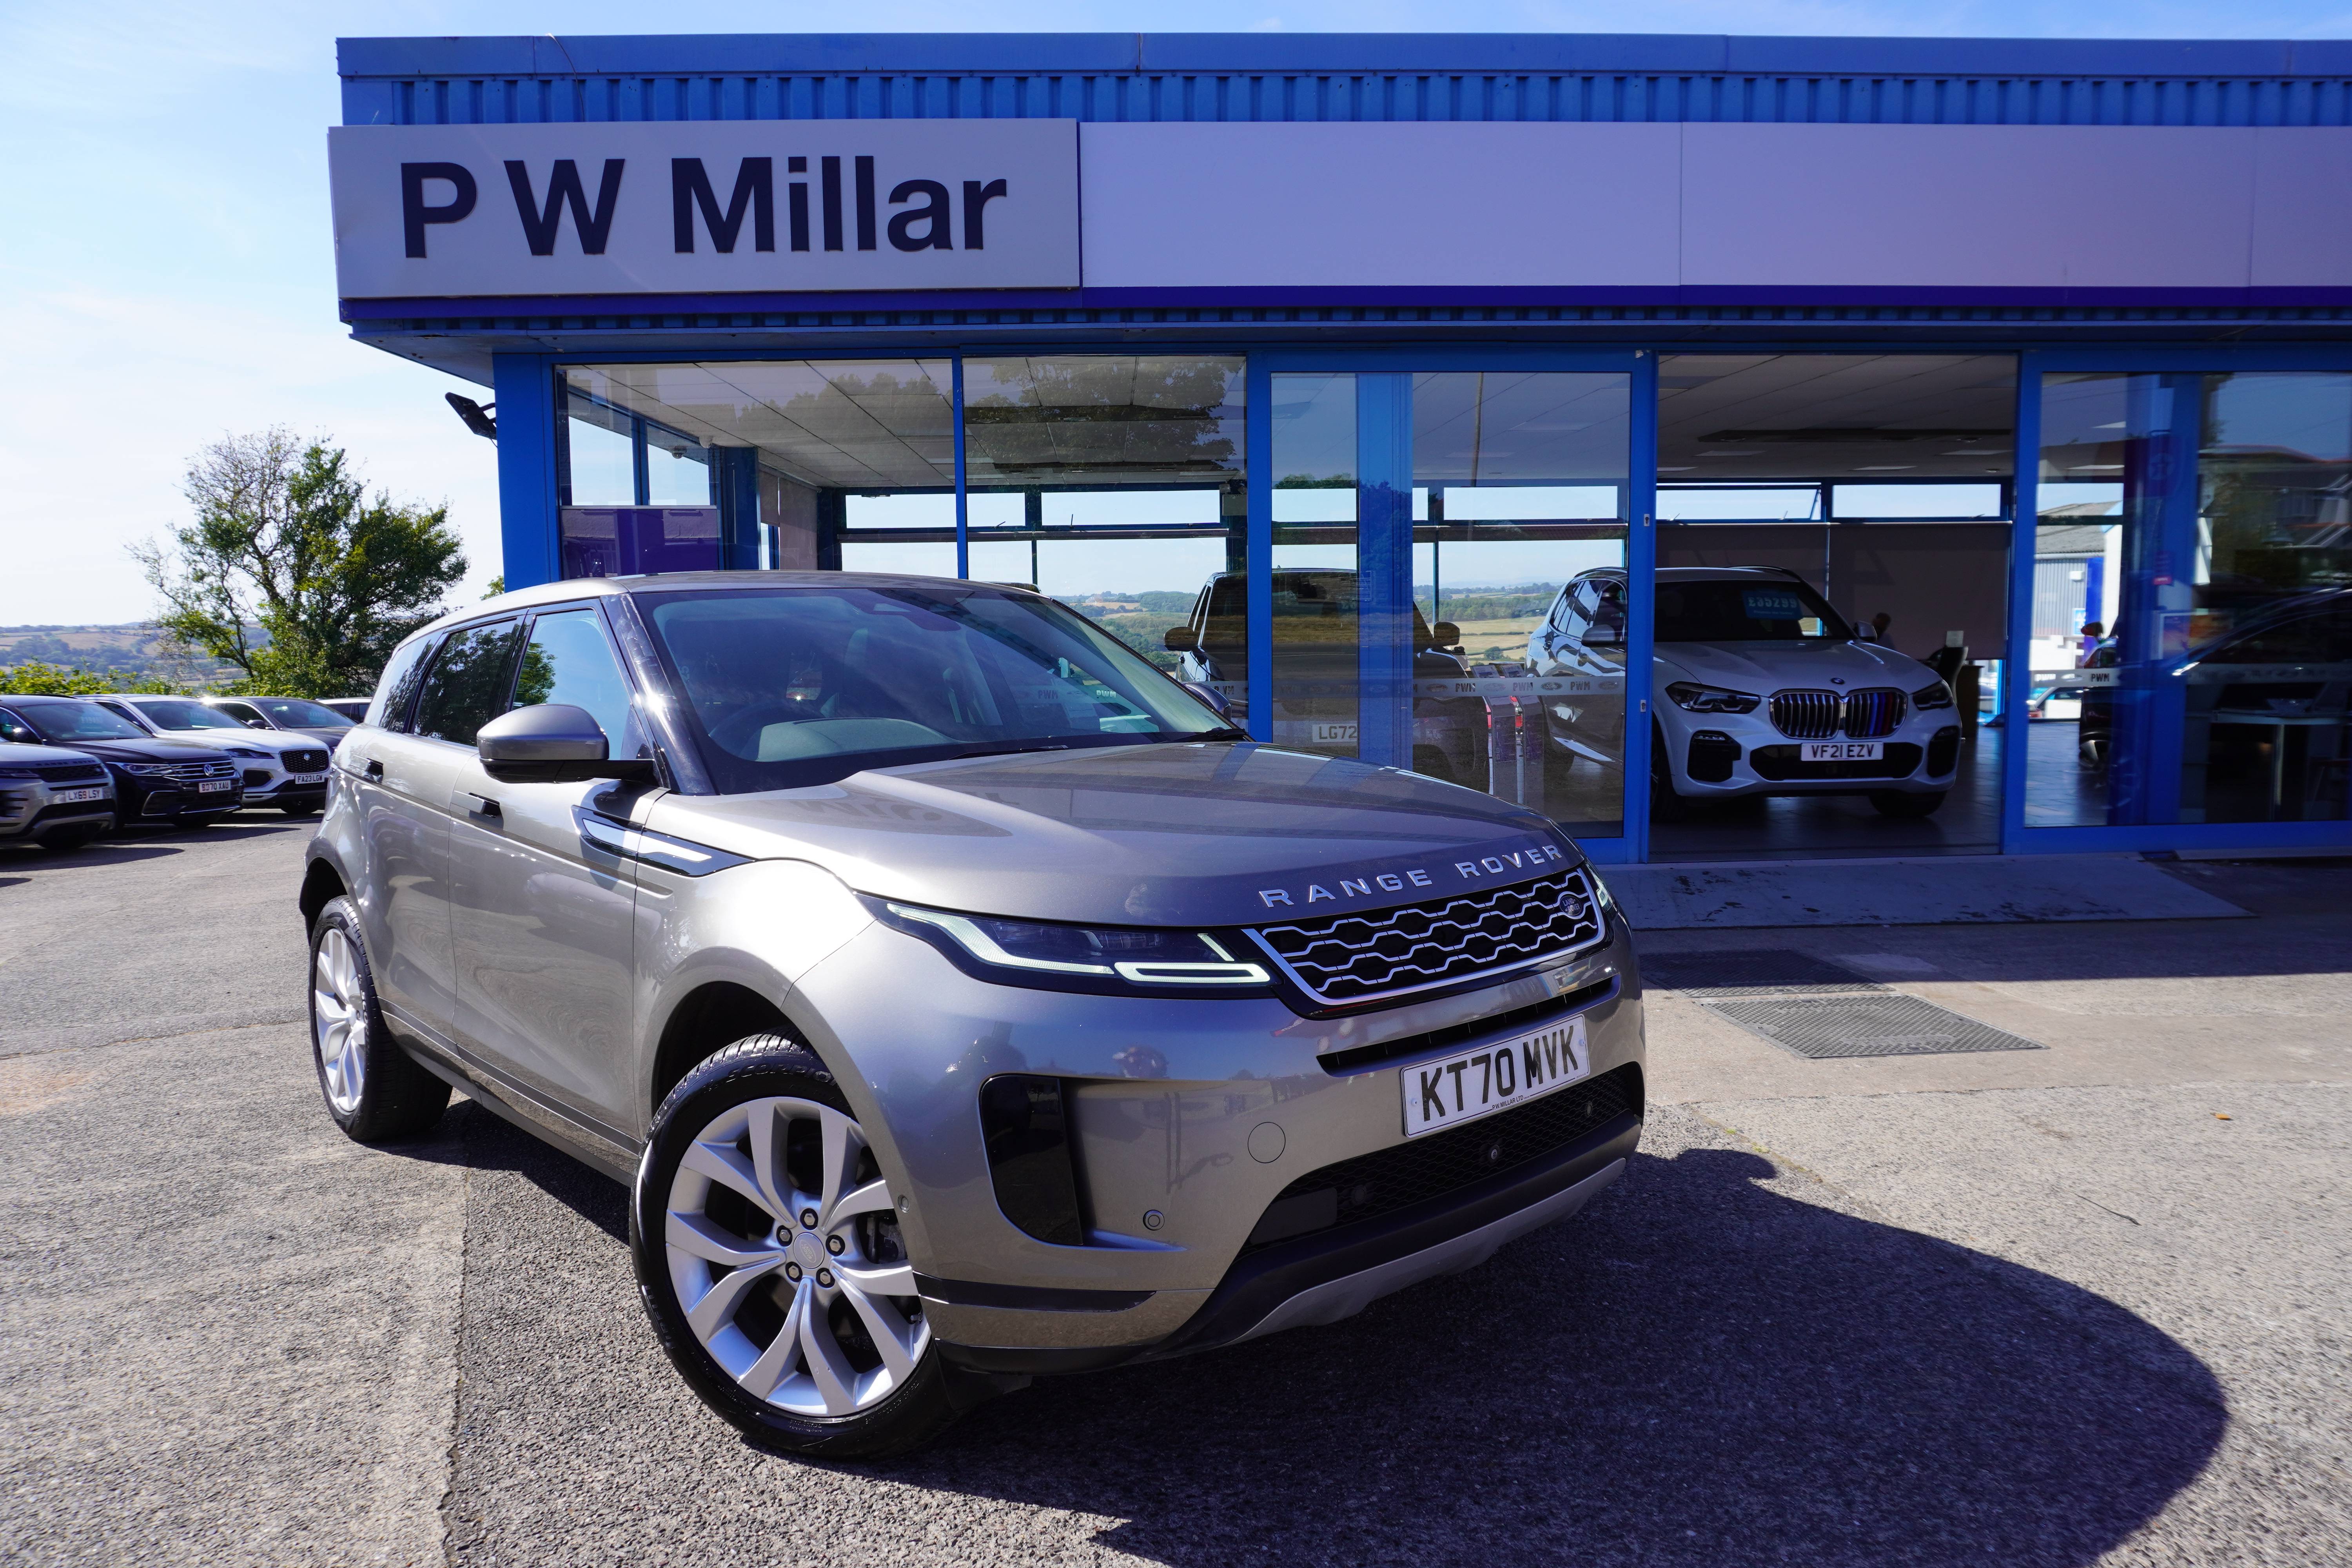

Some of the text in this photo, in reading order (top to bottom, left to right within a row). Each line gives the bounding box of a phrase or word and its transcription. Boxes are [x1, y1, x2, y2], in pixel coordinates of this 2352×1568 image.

[401, 155, 1007, 258] P W Millar
[2091, 673, 2109, 682] PWM
[1455, 683, 1475, 692] PWM
[1513, 682, 1533, 691] PWM
[1570, 681, 1590, 690] PWM
[1039, 690, 1116, 699] PWM PWM
[1319, 726, 1358, 739] LG72
[1811, 744, 1875, 758] VF21 EZV
[1258, 844, 1563, 907] RANGE ROVER
[1563, 898, 1574, 907] LAND
[1568, 903, 1581, 913] ROVER
[1420, 1025, 1578, 1122] KT70 MVK
